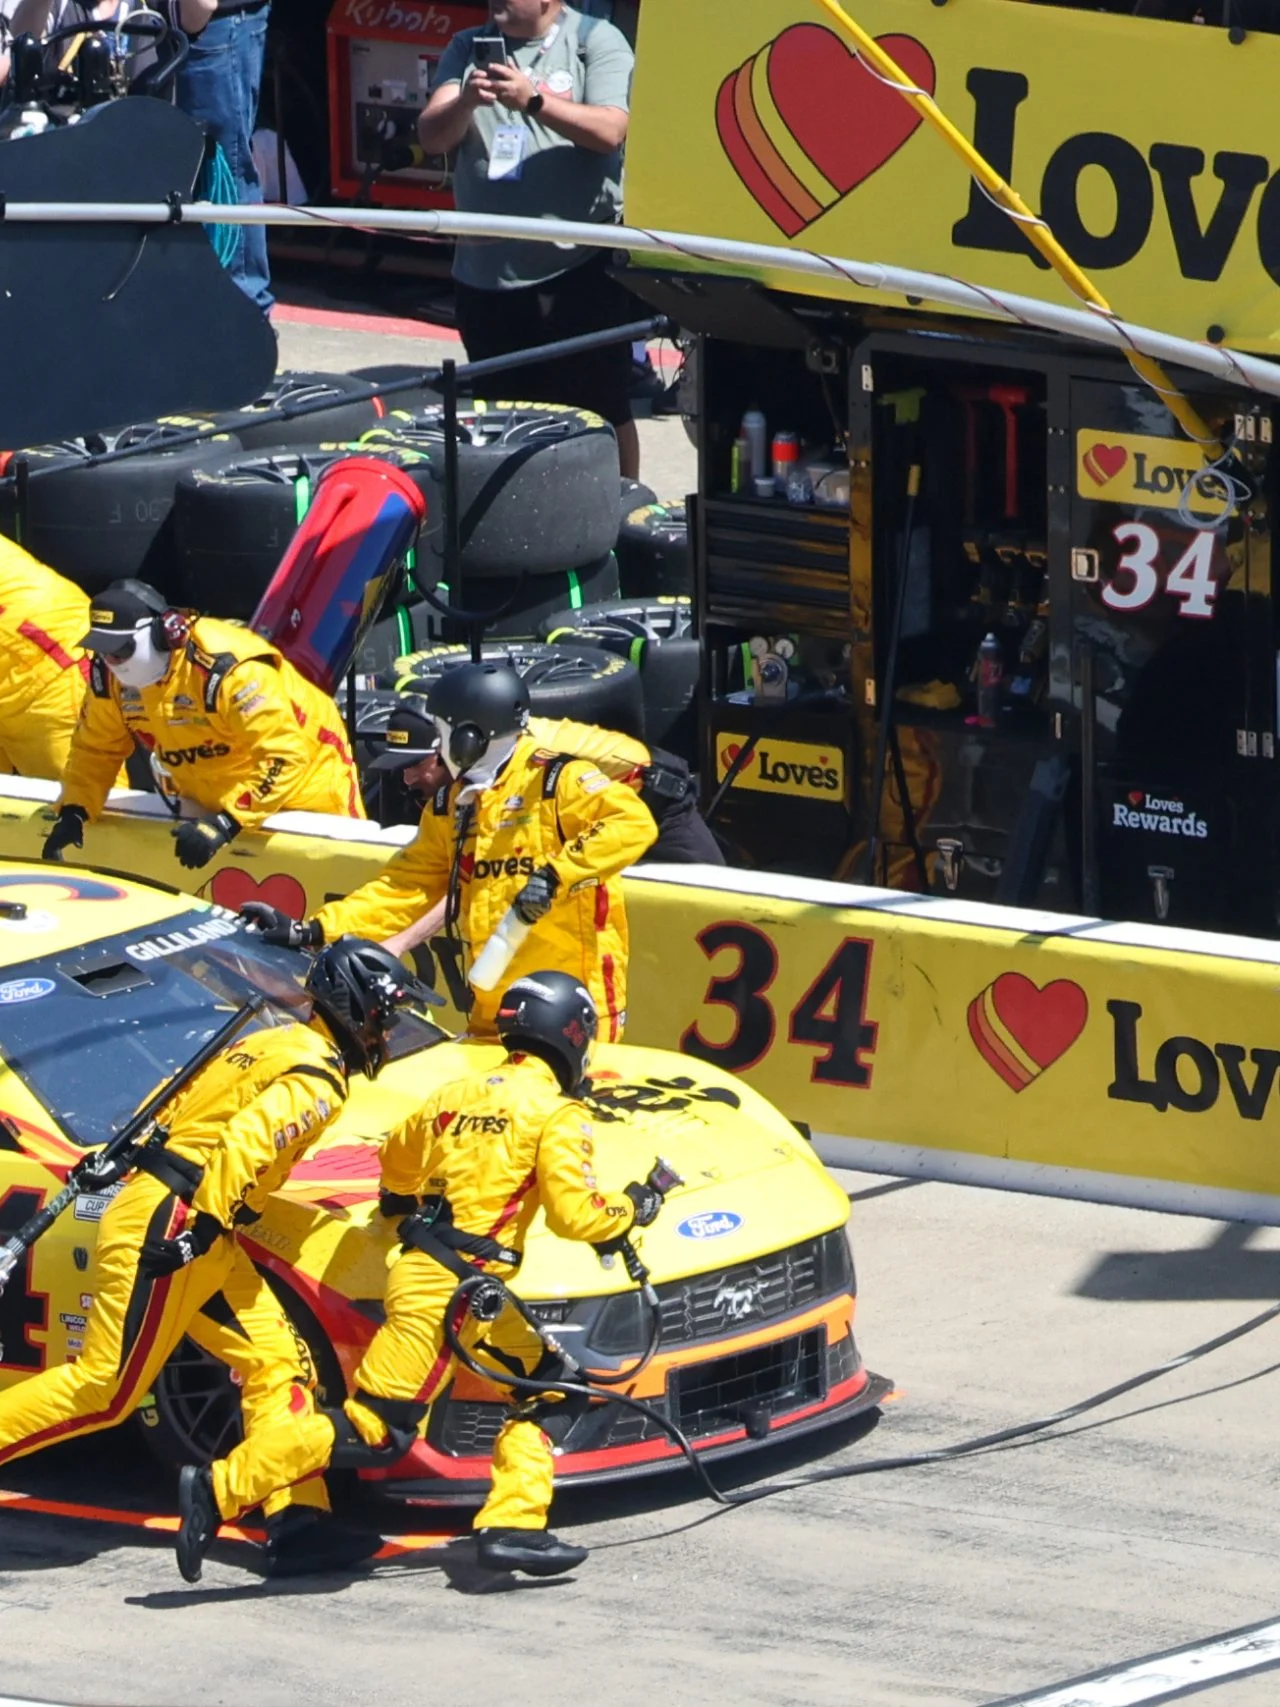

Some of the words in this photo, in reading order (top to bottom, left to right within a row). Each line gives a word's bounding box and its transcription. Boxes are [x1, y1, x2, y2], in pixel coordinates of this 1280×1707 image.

[346, 0, 451, 34] Kubota
[951, 67, 1280, 283] Lov
[1133, 452, 1232, 500] Love
[1101, 521, 1218, 619] 34
[1112, 803, 1208, 838] Rewards
[125, 917, 238, 962] GILLILAND
[680, 921, 880, 1089] 34
[1106, 999, 1280, 1121] Lov
